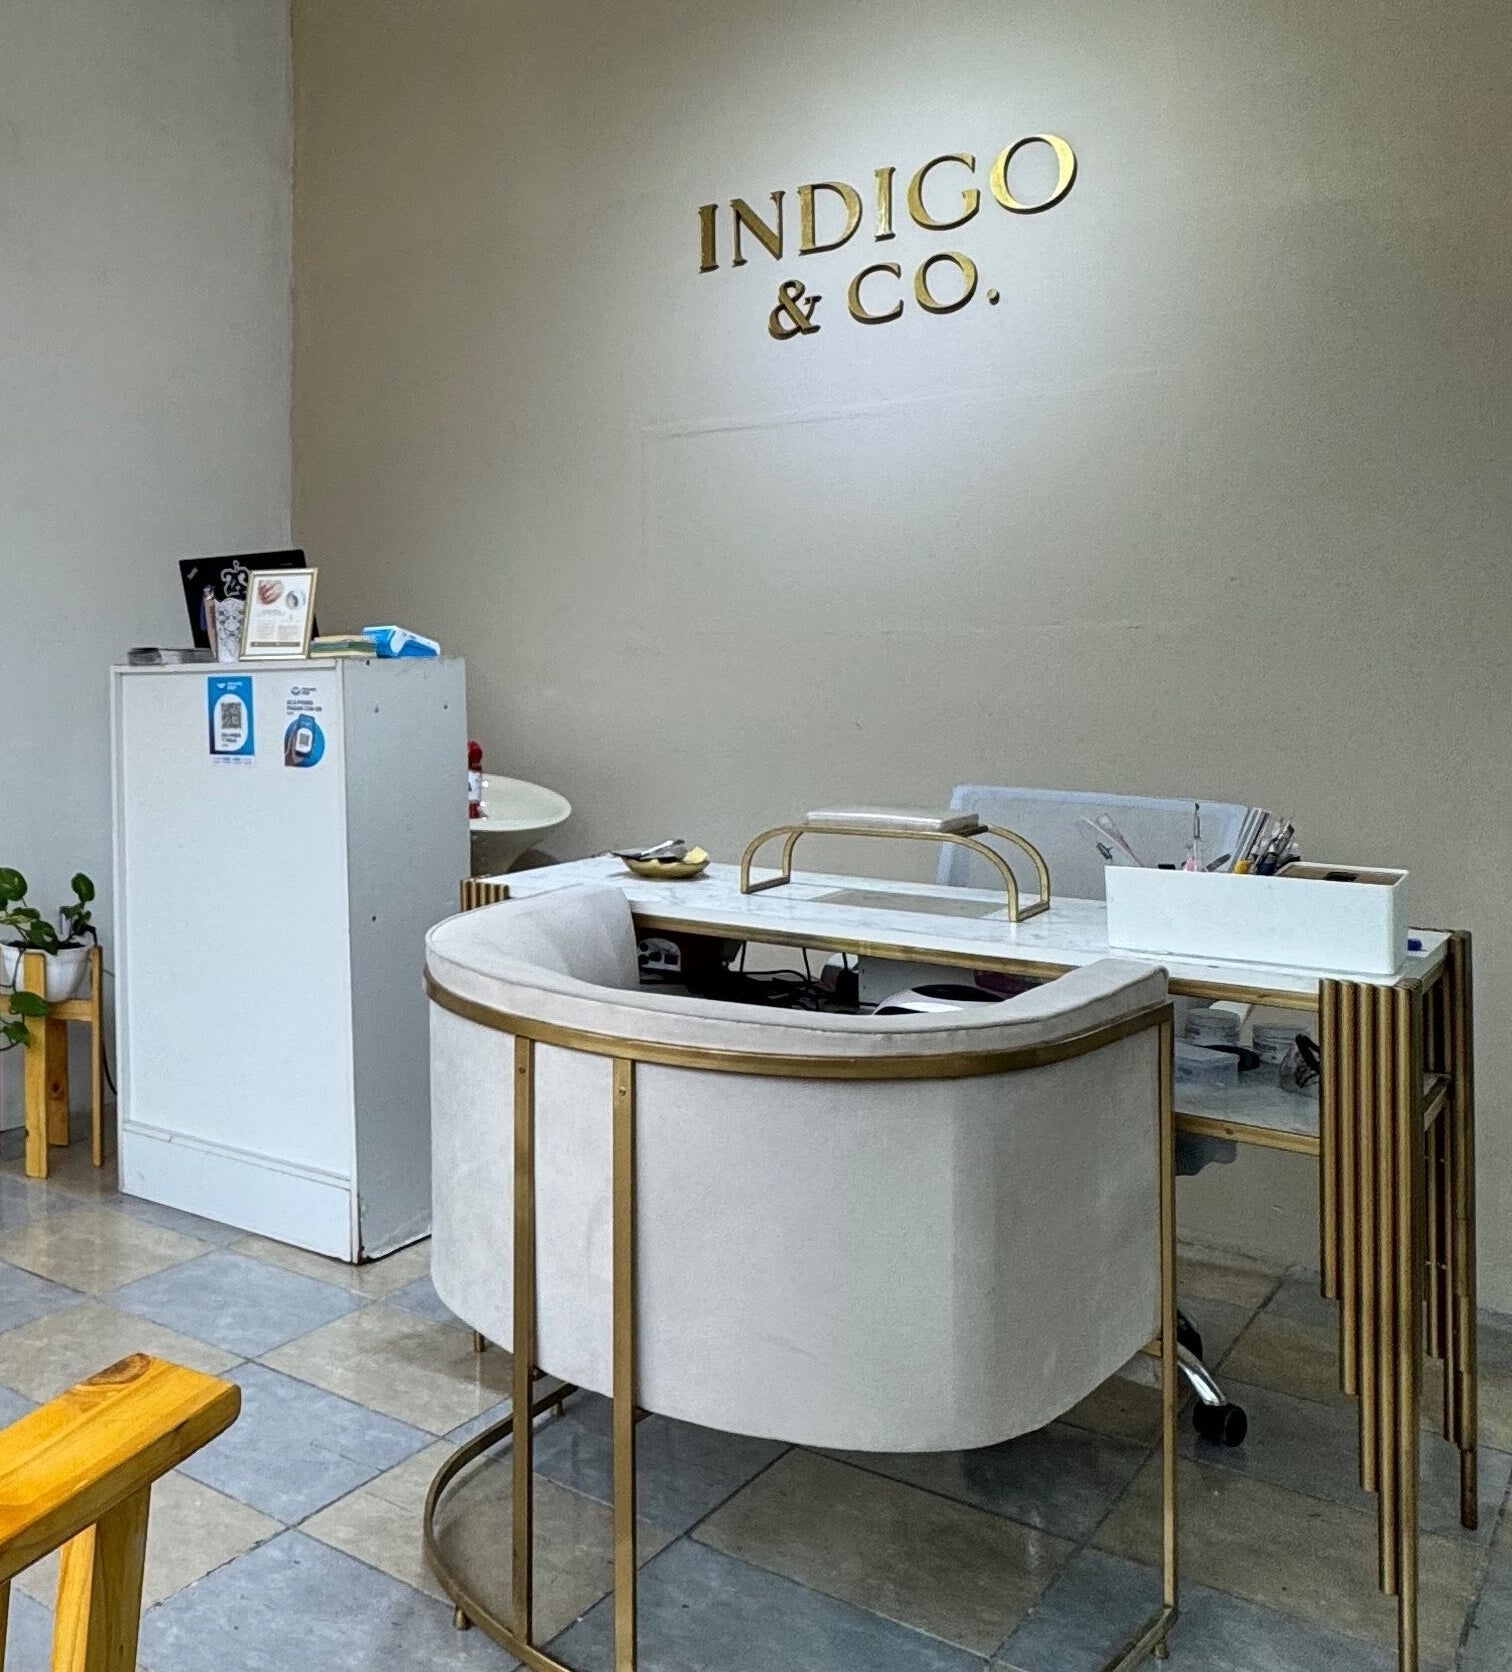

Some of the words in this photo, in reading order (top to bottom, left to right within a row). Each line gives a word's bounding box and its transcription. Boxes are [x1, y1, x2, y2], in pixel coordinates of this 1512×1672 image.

[698, 133, 1078, 274] INDIGO
[768, 279, 822, 340] &
[847, 251, 1000, 325] CO.
